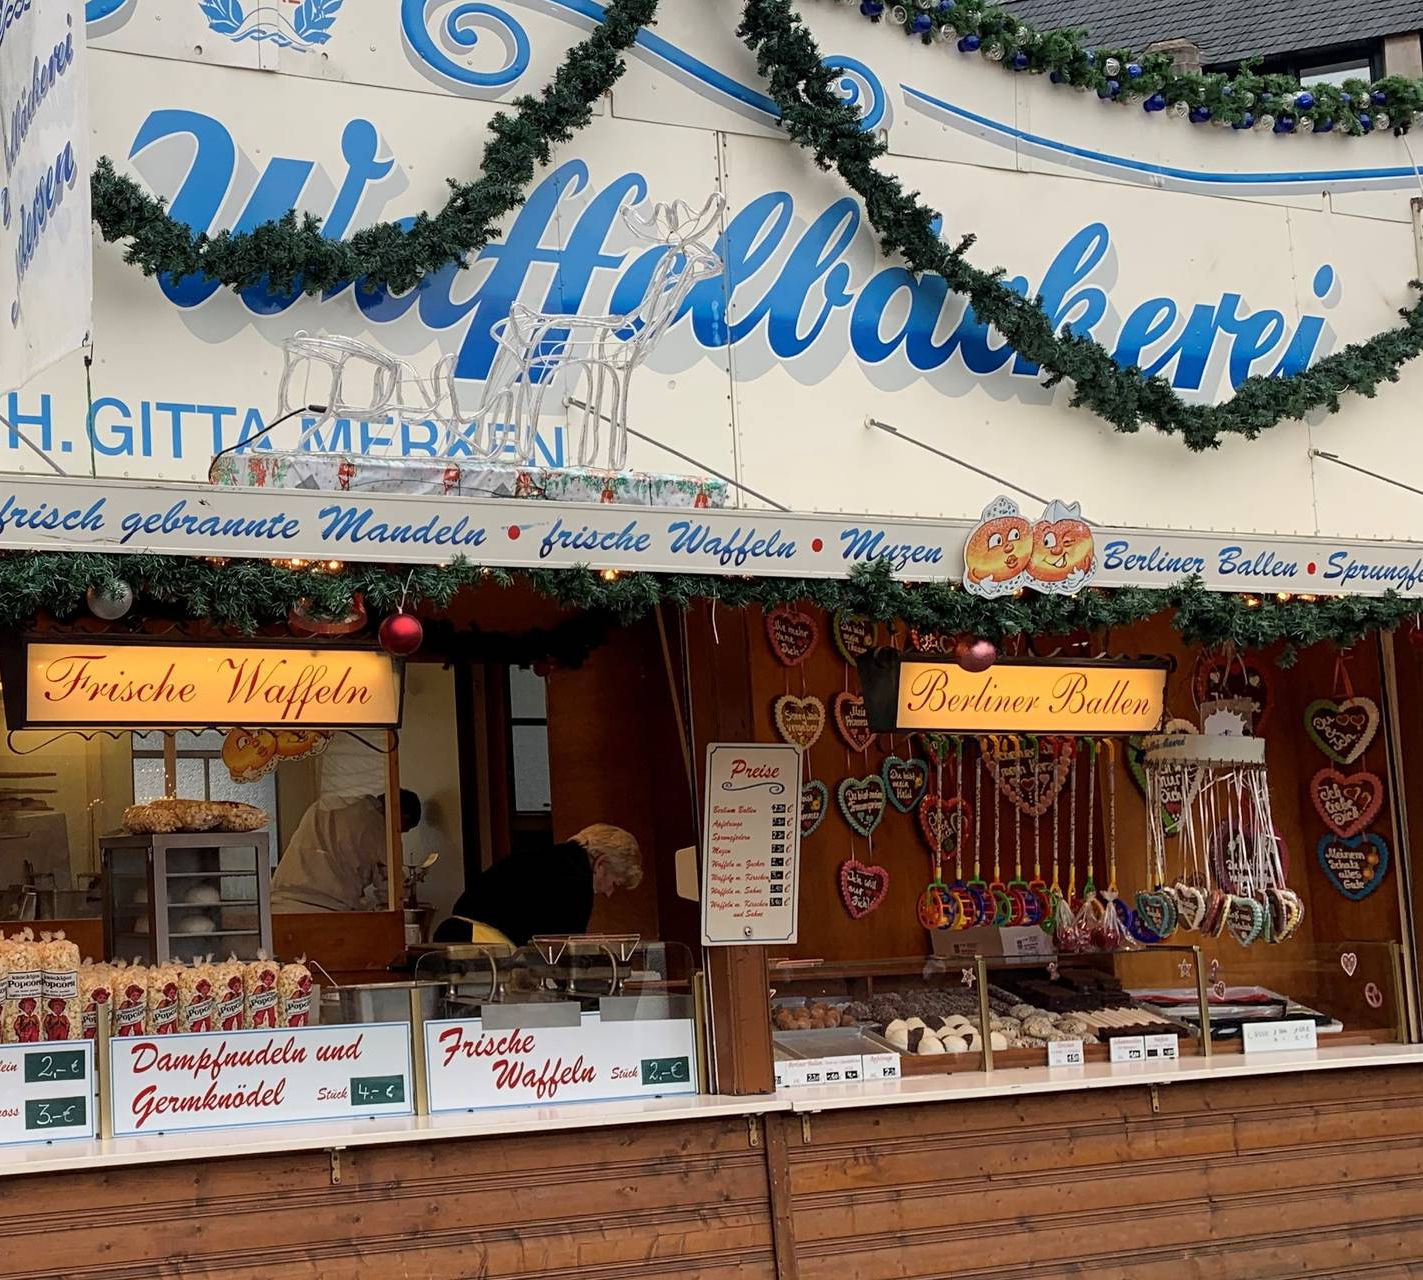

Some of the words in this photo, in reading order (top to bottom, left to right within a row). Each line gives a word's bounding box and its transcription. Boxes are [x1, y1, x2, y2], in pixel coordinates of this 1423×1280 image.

[88, 399, 274, 457] GITTA
[120, 499, 299, 544] gebrannte
[319, 505, 487, 546] Mandeln
[539, 519, 651, 558] frische
[668, 521, 797, 568] Waffeln
[840, 528, 943, 570] Muzen
[1104, 541, 1205, 573] Berliner
[1218, 546, 1298, 577] Ballen
[44, 655, 197, 702] Frische
[217, 658, 373, 720] Waffeln
[908, 669, 1040, 714] Berliner
[1049, 672, 1151, 716] Ballen
[731, 759, 780, 780] Preise
[7, 979, 42, 989] Popcorn
[42, 978, 75, 989] Popcorn
[132, 1036, 307, 1079] Dampfnudeln
[316, 1033, 363, 1062] und
[438, 1027, 536, 1067] Frische
[492, 1055, 597, 1099] Waffeln
[610, 1065, 638, 1080] Stück
[132, 1077, 286, 1128] Germknödel
[317, 1087, 348, 1101] Stück
